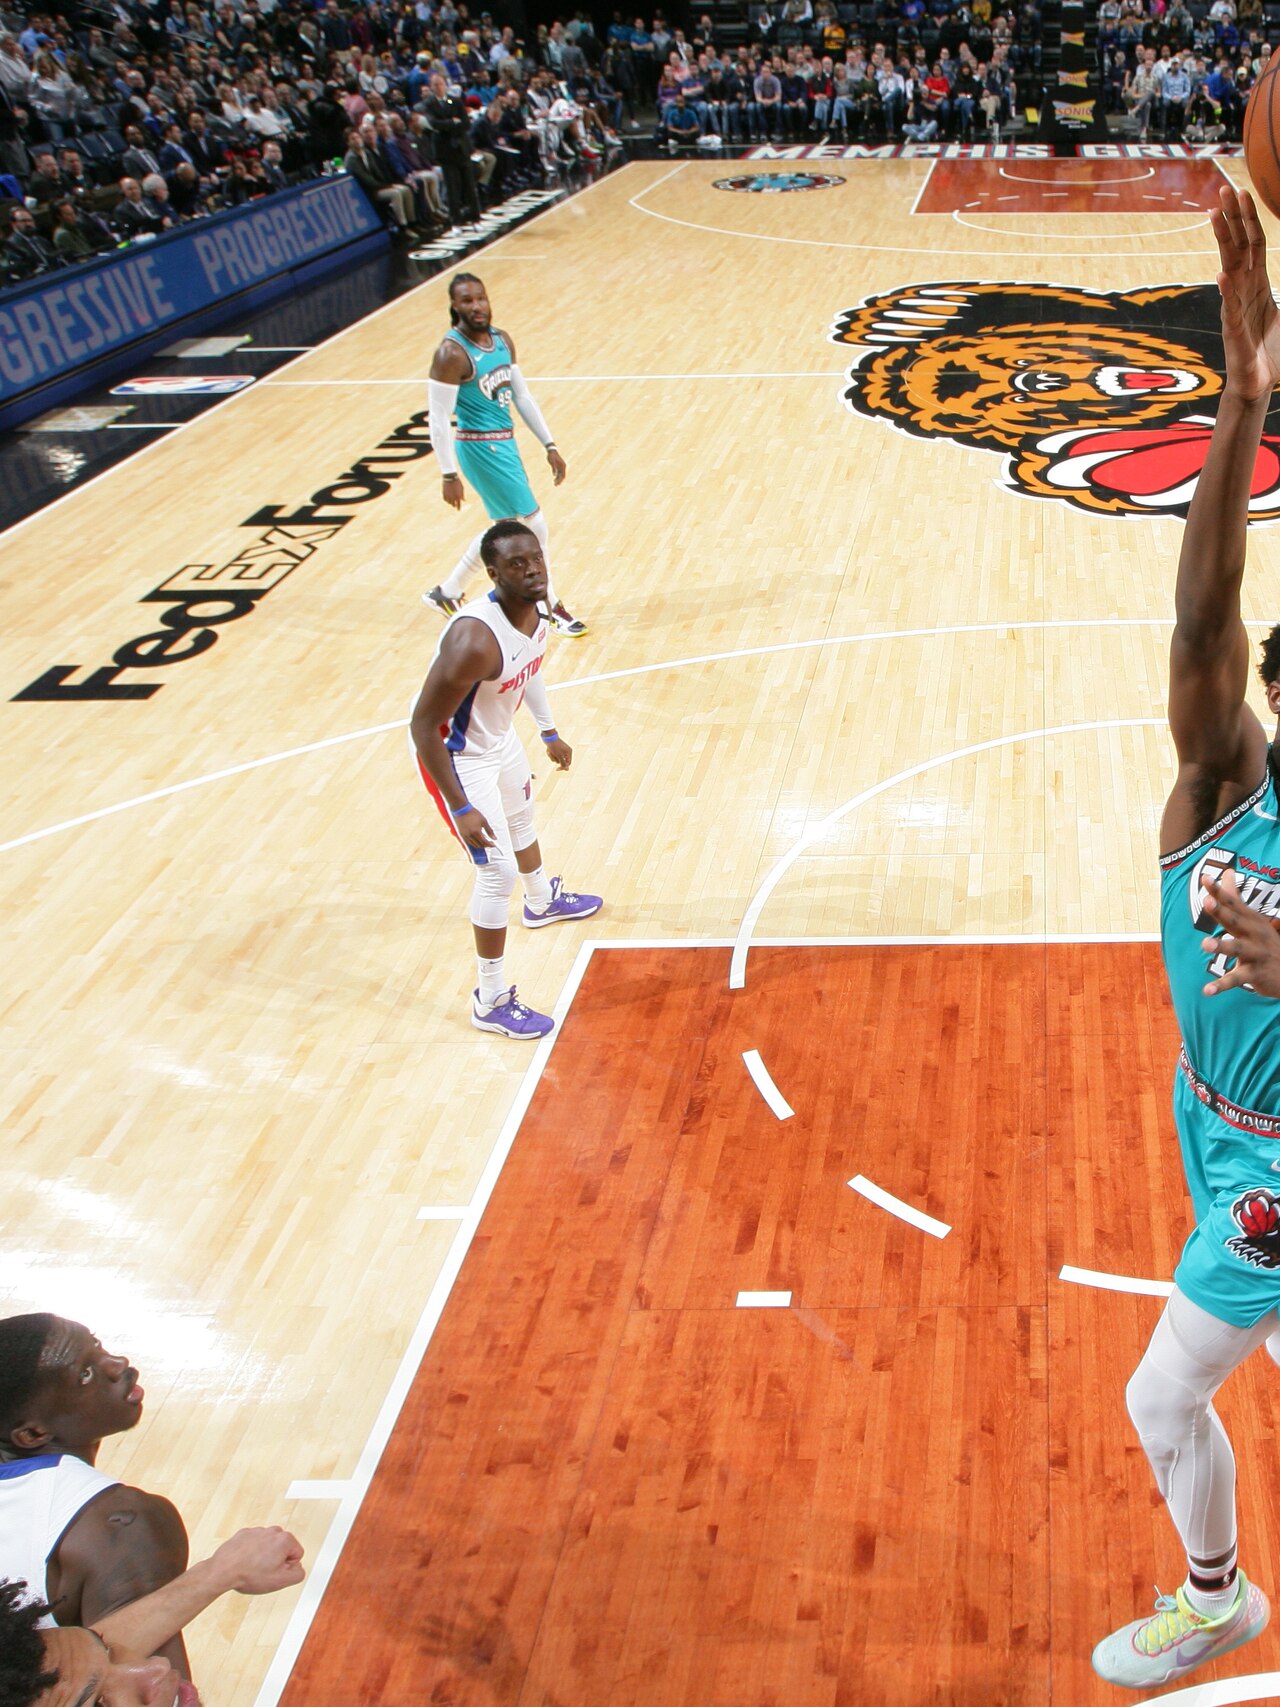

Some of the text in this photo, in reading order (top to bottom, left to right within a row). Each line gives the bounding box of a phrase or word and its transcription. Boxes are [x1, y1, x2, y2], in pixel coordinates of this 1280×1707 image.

[1055, 107, 1092, 117] SONIC
[748, 143, 1053, 159] MEMPHIS
[193, 182, 368, 295] PROGRESSIVE
